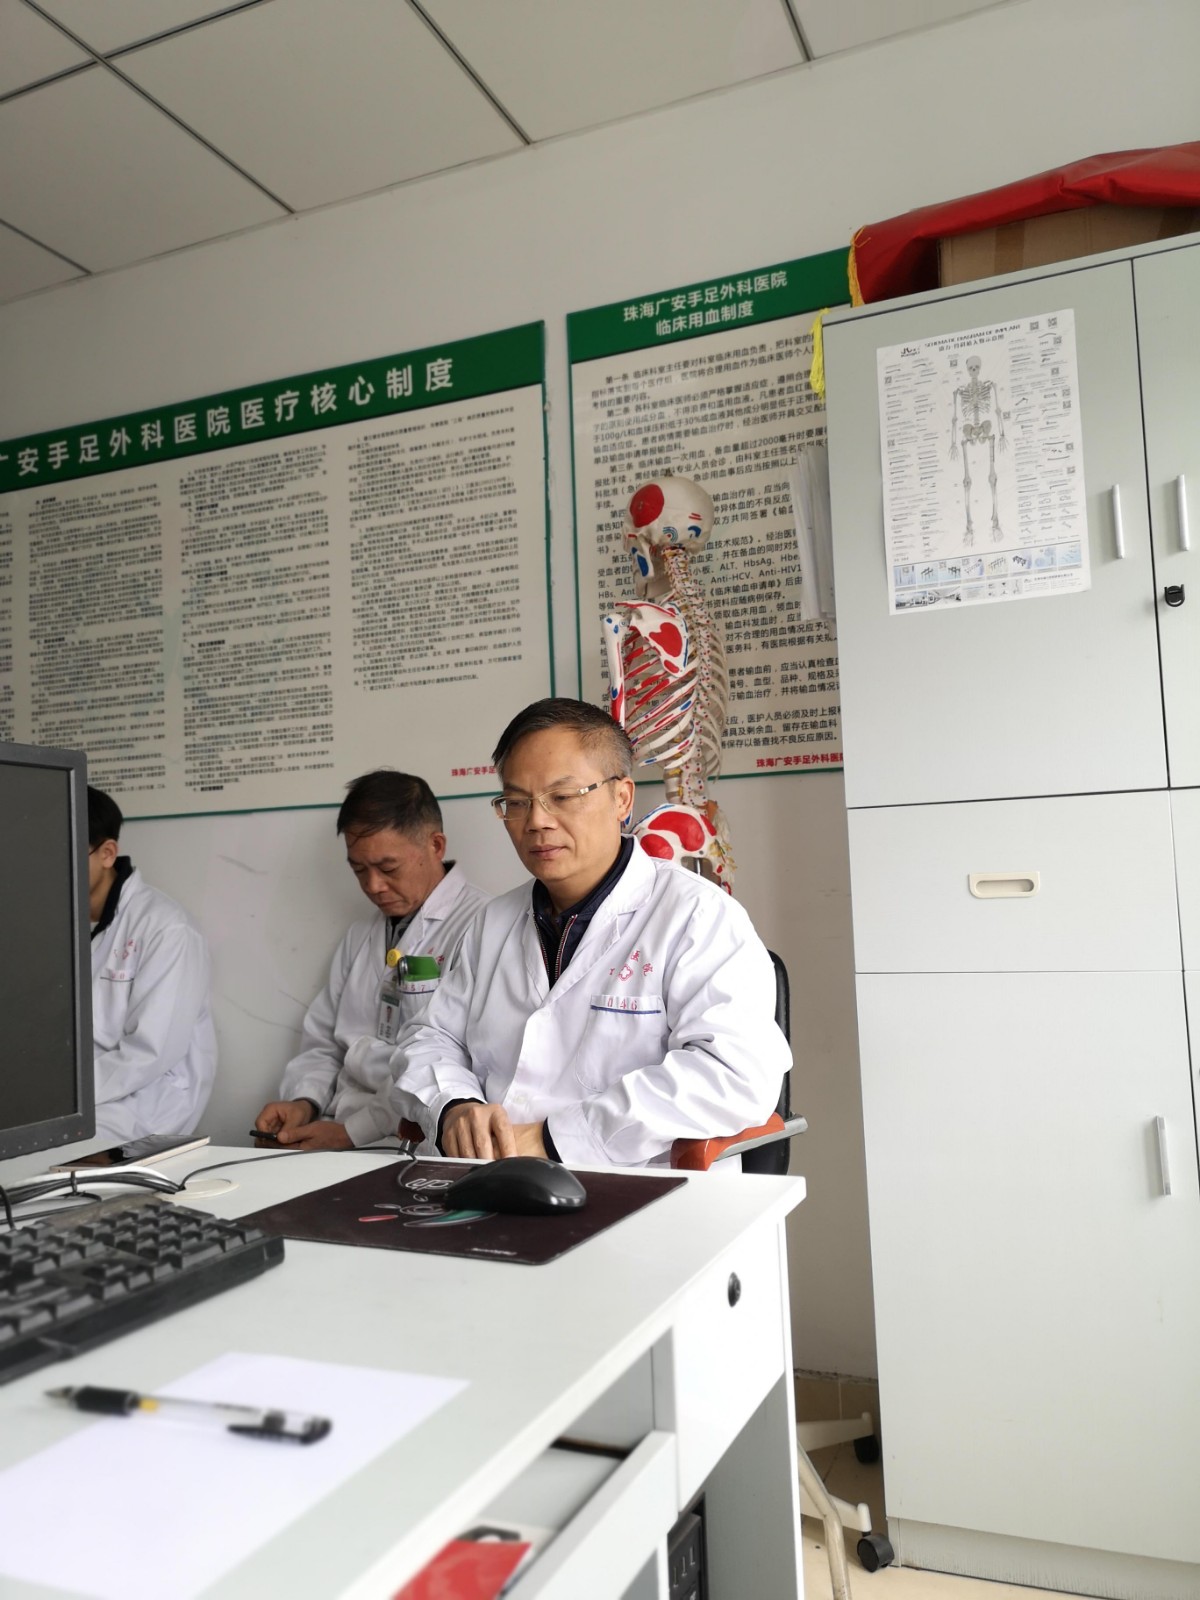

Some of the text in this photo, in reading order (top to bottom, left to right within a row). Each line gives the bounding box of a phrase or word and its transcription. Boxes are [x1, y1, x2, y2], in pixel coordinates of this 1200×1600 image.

[624, 271, 787, 322] 珠海广安手足外科医院
[656, 301, 754, 336] 临床用血制度
[633, 333, 813, 379] 临床科室主任要对科室临床用血负责，把科室的
[0, 357, 454, 477] 安手足外科医院医疗核心制度
[609, 462, 632, 473] 第三条
[595, 499, 614, 510] 手续。
[596, 520, 623, 532] 属告知
[704, 528, 796, 550] 血技术规范》。经治医
[597, 564, 632, 577] 受血者的
[598, 576, 635, 588] 型、血红
